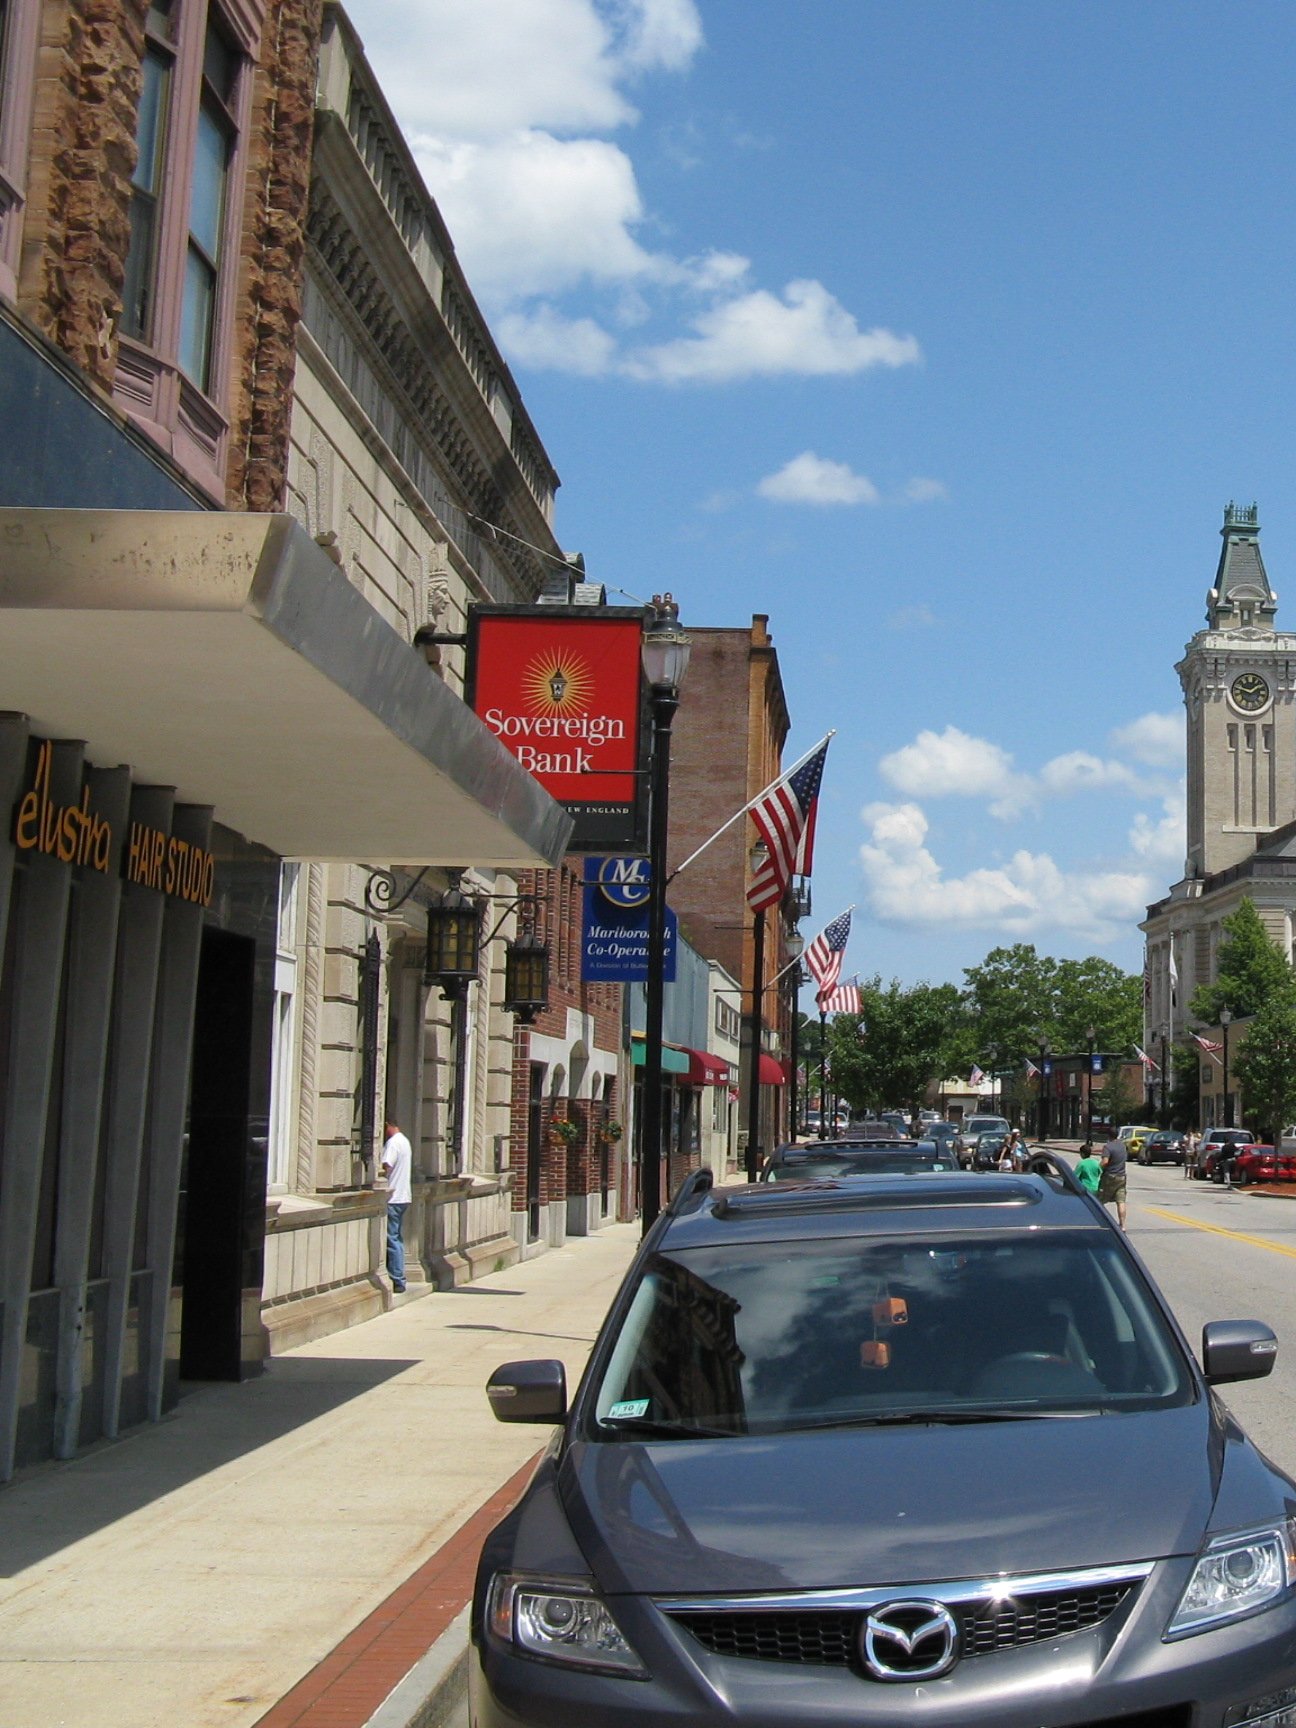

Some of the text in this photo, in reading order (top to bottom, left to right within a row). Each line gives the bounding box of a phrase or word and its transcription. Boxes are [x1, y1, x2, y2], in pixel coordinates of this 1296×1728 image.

[485, 708, 626, 746] Sovereign
[516, 745, 594, 774] Bank
[587, 806, 630, 814] ENGLAND
[128, 821, 166, 891] HAIR
[166, 836, 214, 907] STUDIO
[587, 925, 671, 939] Marlboroh
[587, 942, 671, 958] Co-Operae
